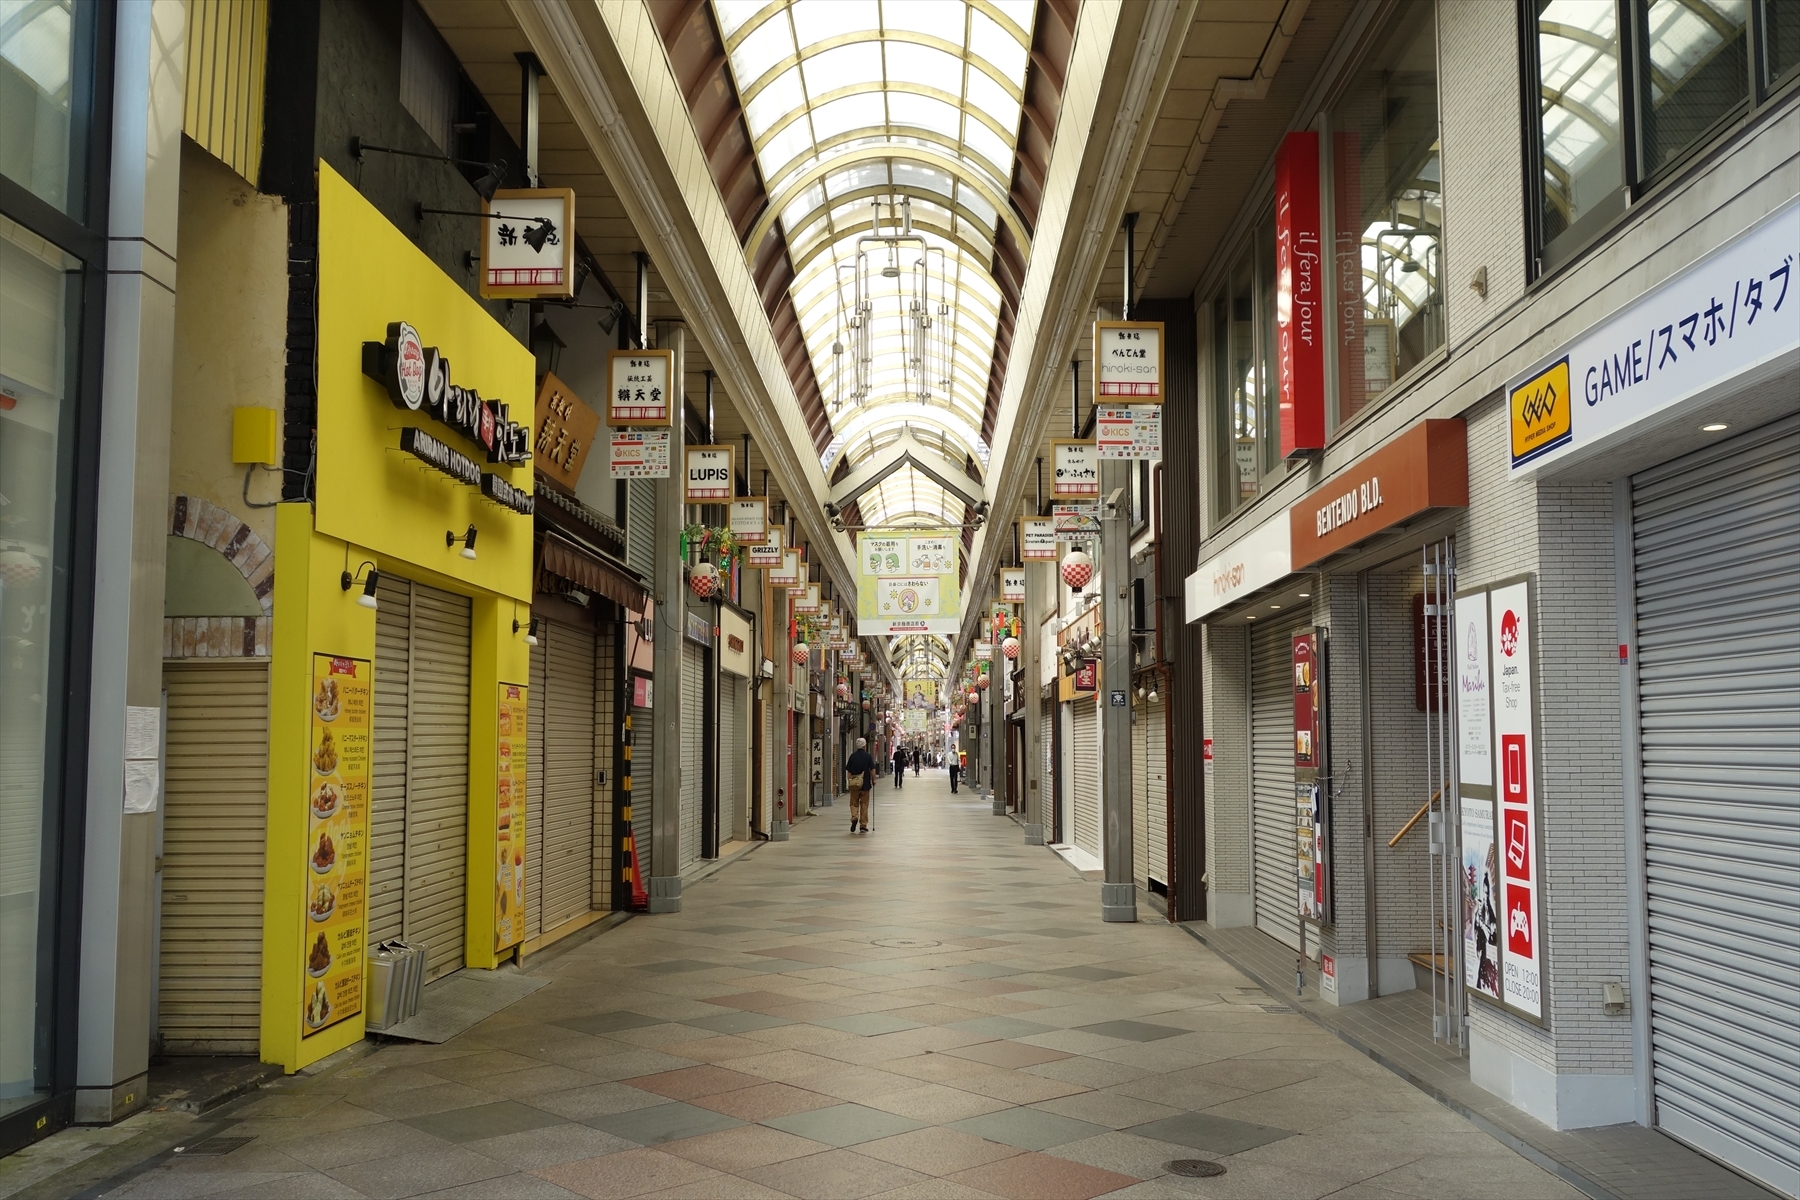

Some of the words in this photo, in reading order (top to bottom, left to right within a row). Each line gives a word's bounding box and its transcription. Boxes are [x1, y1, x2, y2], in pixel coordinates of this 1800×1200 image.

[1299, 232, 1318, 244] il
[1294, 245, 1318, 294] fera
[1295, 294, 1316, 346] jour
[1584, 253, 1800, 407] GAME/スマホ/タブ
[1112, 348, 1146, 358] べんてん堂
[1101, 363, 1156, 374] hiroki-san
[1110, 428, 1130, 436] KICS
[1525, 431, 1536, 443] HYPER
[1536, 427, 1546, 438] MEDIA
[1546, 422, 1556, 432] SHOP
[413, 428, 449, 468] ARIRANG
[450, 449, 480, 486] HOTDOG
[623, 449, 640, 457] KICS
[690, 468, 728, 480] LUPIS
[1317, 489, 1358, 537] BENTENDO
[1361, 477, 1382, 513] BLD.
[1502, 681, 1521, 693] Tax-free
[1505, 696, 1517, 709] Shop
[1504, 961, 1519, 979] OPEN
[1522, 968, 1538, 987] 12:00
[1504, 978, 1522, 998] CLOSE
[1522, 985, 1539, 1005] 20:00
